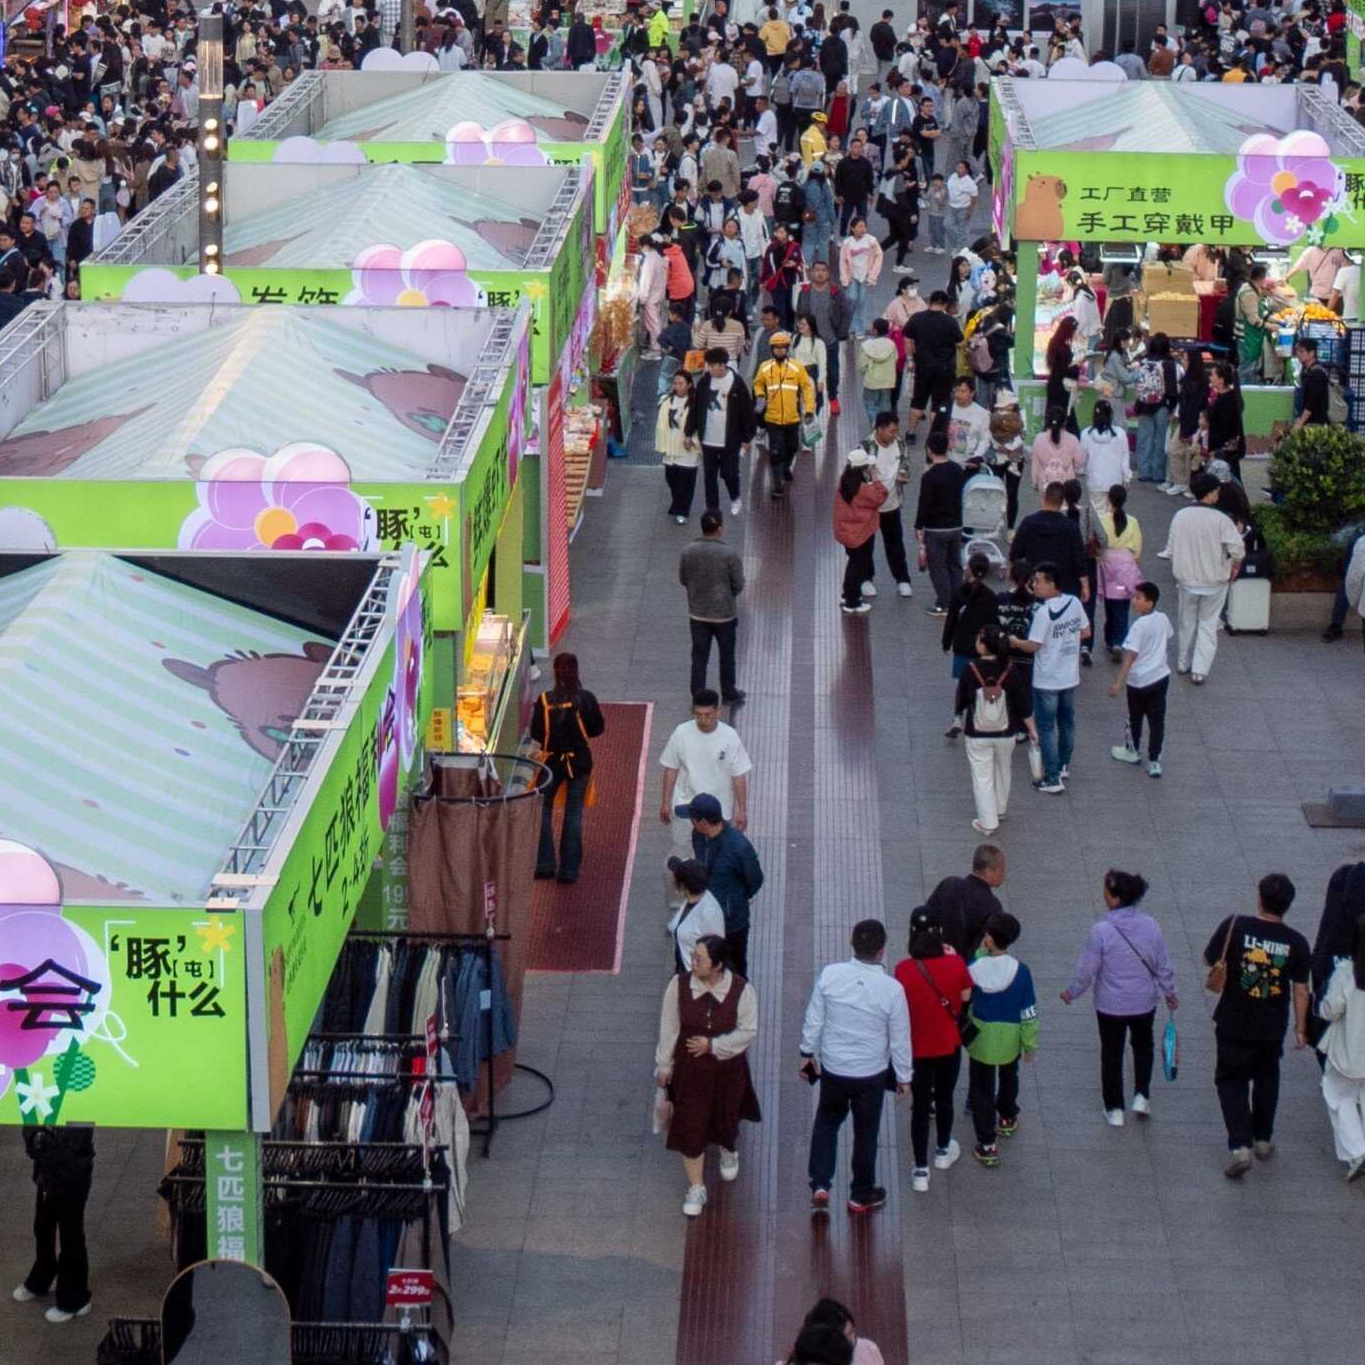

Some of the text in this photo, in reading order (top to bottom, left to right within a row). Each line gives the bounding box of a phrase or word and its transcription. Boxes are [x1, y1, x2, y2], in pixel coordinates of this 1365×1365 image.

[1079, 185, 1172, 204] 工厂直营
[1076, 211, 1235, 236] 手工穿戴甲
[1244, 934, 1291, 958] LI-NING
[146, 979, 228, 1018] 什么
